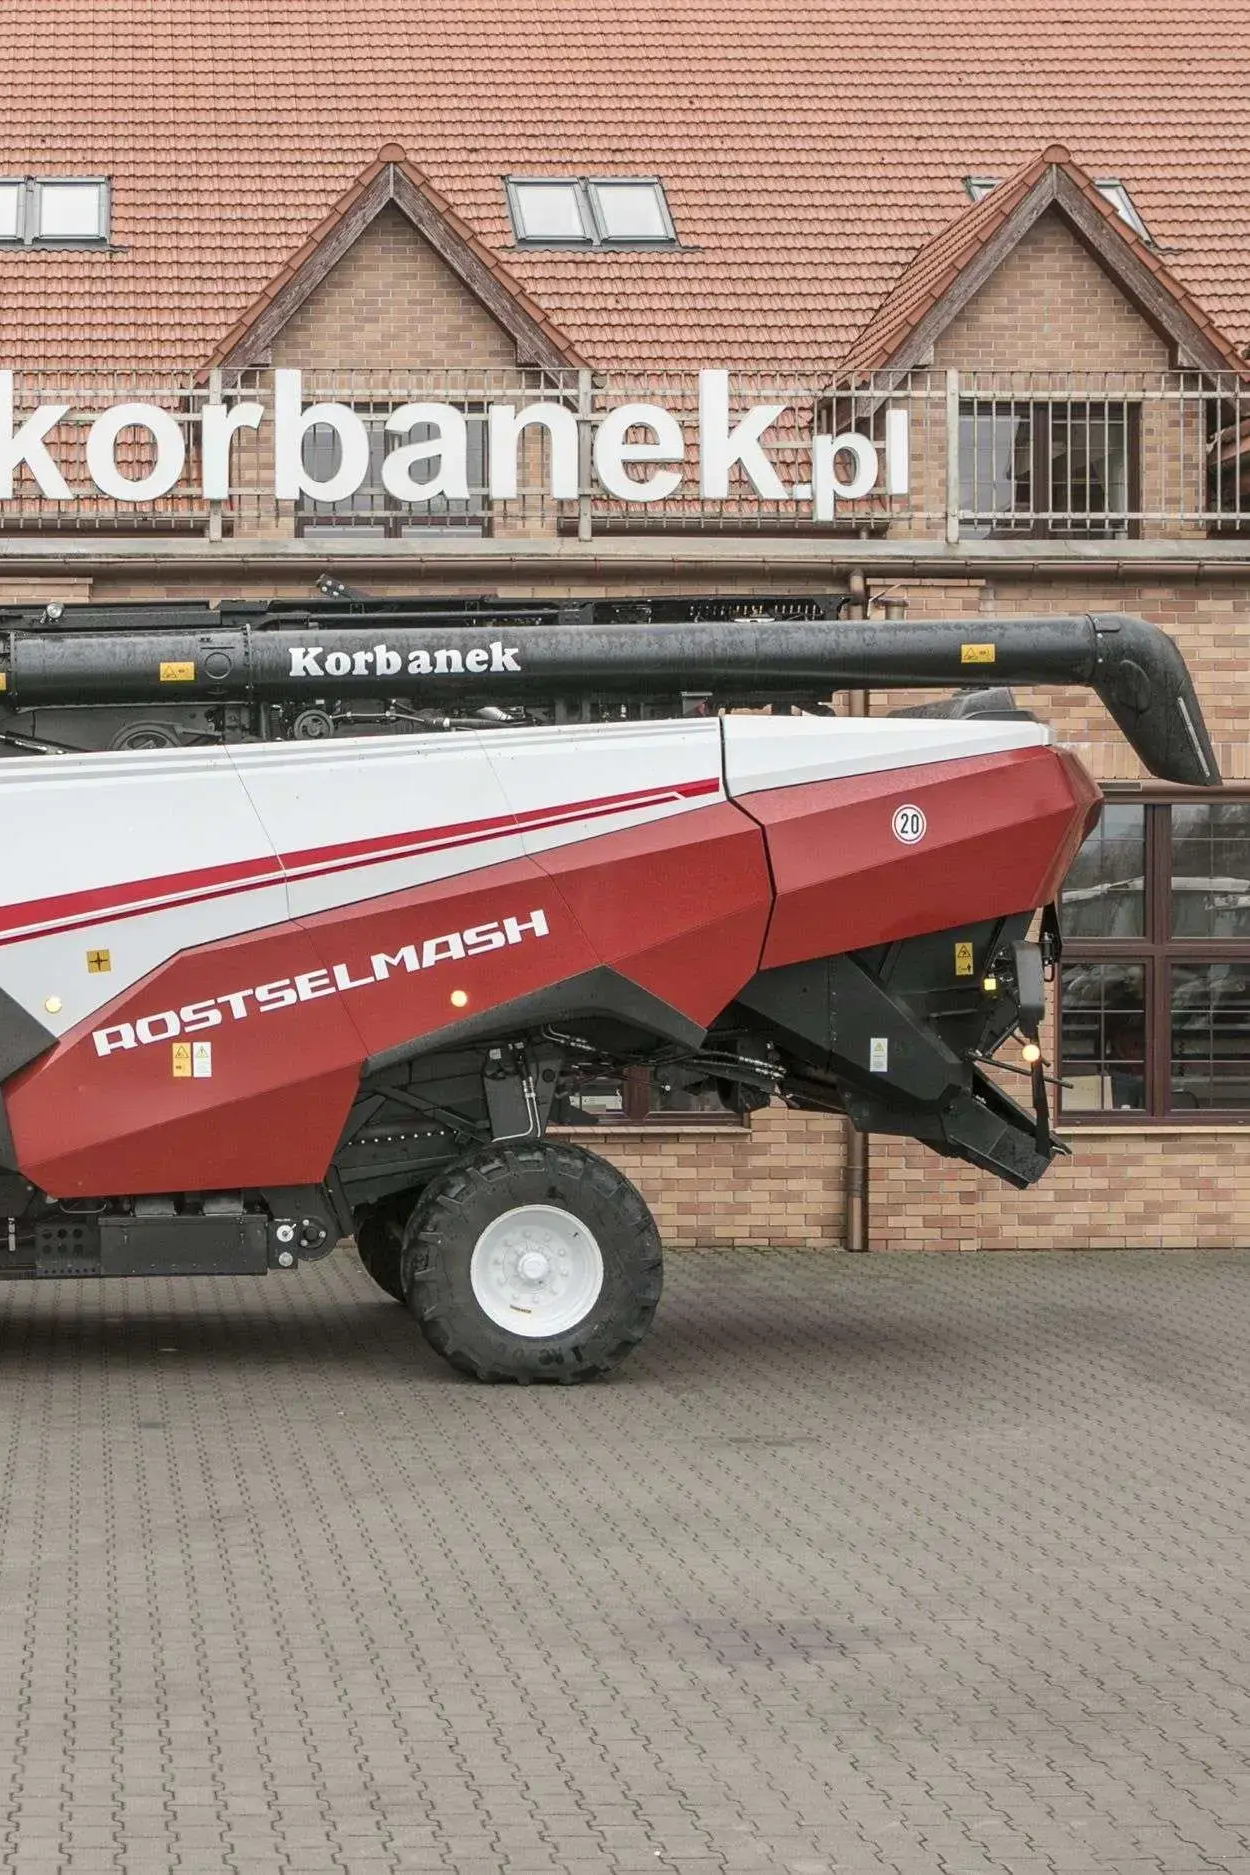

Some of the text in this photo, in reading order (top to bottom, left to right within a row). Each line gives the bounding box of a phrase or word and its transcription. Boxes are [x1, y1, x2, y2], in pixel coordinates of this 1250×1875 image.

[288, 642, 521, 676] Korbanek
[900, 813, 919, 834] 20
[92, 909, 550, 1057] ROSTSELMASH
